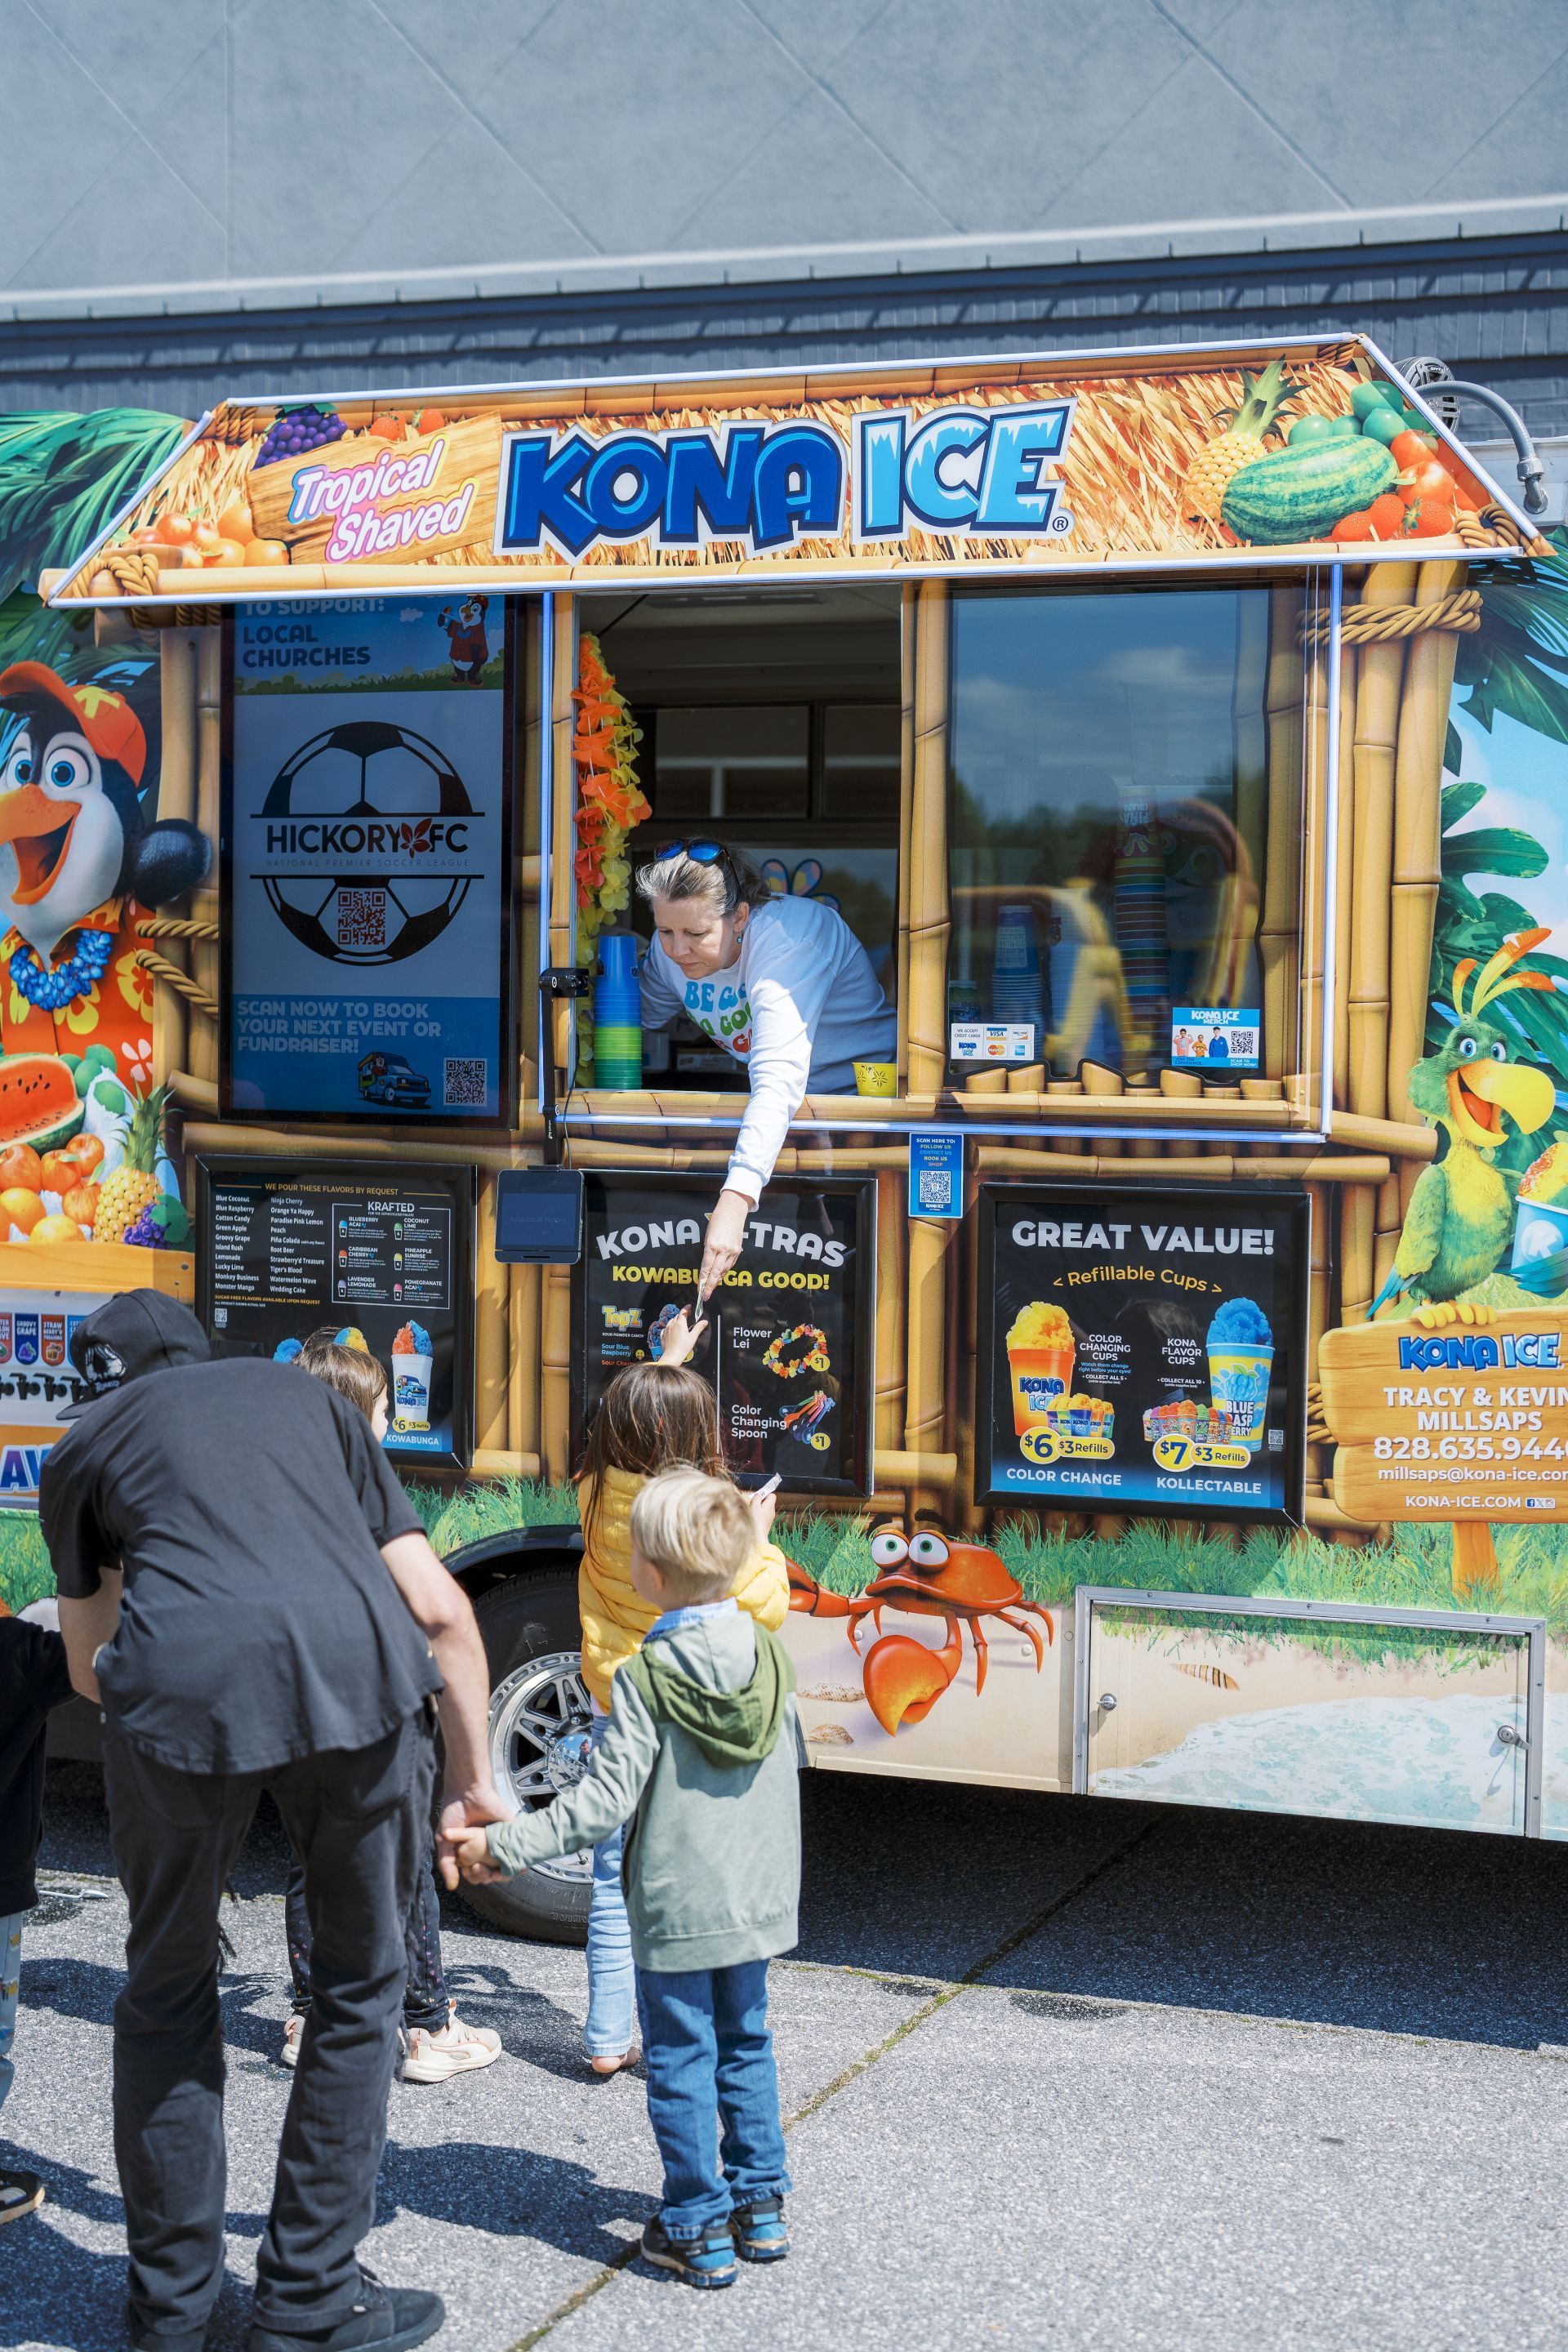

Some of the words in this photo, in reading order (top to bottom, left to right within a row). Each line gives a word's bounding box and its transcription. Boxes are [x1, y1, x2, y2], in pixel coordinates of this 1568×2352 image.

[292, 436, 447, 520] Tropical
[501, 424, 844, 559] KONA
[860, 405, 1070, 537] ICE
[327, 480, 475, 562] Shaved
[245, 600, 272, 616] TO
[278, 597, 384, 616] SUPPORT:
[243, 624, 318, 644] LOCAL
[243, 645, 371, 668] CHURCHES
[267, 823, 400, 853] HICKORY
[430, 822, 469, 853] FC
[266, 858, 319, 867] NATIONAL
[326, 858, 371, 867] PREMIER
[377, 858, 421, 867] SOCCER
[427, 858, 469, 867] LEAGUE
[684, 981, 715, 1012] BE
[237, 1000, 285, 1017] SCAN
[290, 1001, 337, 1018] NOW
[342, 1002, 368, 1018] TO
[373, 1003, 429, 1019] BOOK
[1191, 1010, 1221, 1020] KONA
[1222, 1010, 1240, 1021] ICE
[237, 1018, 288, 1035] YOUR
[293, 1019, 341, 1036] NEXT
[346, 1021, 409, 1037] EVENT
[412, 1022, 442, 1037] OR
[237, 1036, 359, 1054] FUNDRAISER!
[300, 1184, 321, 1192] THESE
[323, 1185, 354, 1194] FLAVORS
[367, 1187, 399, 1196] REQUEST
[270, 1197, 284, 1205] Ninja
[368, 1201, 414, 1213] KRAFTED
[229, 1205, 254, 1214] Raspberry
[270, 1207, 289, 1215] Orange
[234, 1215, 250, 1223] Candy
[216, 1234, 234, 1242] Groovy
[595, 1218, 700, 1260] KONA
[739, 1221, 847, 1267] -TRAS
[1012, 1220, 1131, 1250] GREAT
[1140, 1225, 1274, 1255] VALUE!
[216, 1273, 235, 1281] Monkey
[270, 1276, 301, 1284] Watermelon
[612, 1265, 752, 1287] KOWABGA
[758, 1271, 829, 1290] GOOD!
[1067, 1265, 1155, 1287] Refillable
[1160, 1269, 1207, 1293] Cups
[238, 1284, 255, 1292] Mango
[270, 1285, 292, 1294] Wedding
[602, 1305, 642, 1331] TopZ
[16, 1327, 37, 1335] GRAPE
[733, 1327, 772, 1338] Flower
[733, 1339, 750, 1348] Lei
[1089, 1334, 1122, 1343] COLOR
[1167, 1339, 1196, 1348] KONA
[1080, 1343, 1130, 1352] CHANGING
[1161, 1347, 1202, 1356] FLAVOR
[1398, 1334, 1499, 1372] KONA
[1501, 1332, 1561, 1370] ICE
[815, 1357, 824, 1368] $1
[1092, 1352, 1118, 1361] CUPS
[1168, 1356, 1195, 1365] CUPS
[1019, 1377, 1064, 1395] KONA
[1383, 1387, 1466, 1407] TRACY
[1472, 1387, 1493, 1407] &
[732, 1405, 761, 1414] Color
[1225, 1400, 1254, 1414] BLUE
[394, 1419, 406, 1430] $6
[732, 1416, 786, 1430] Changing
[1417, 1410, 1543, 1432] MILLSAPS
[386, 1434, 439, 1446] KOWABUNGA
[732, 1428, 768, 1439] Spoon
[815, 1436, 825, 1447] $1
[1024, 1433, 1053, 1458] $6
[1059, 1440, 1074, 1454] $3
[1075, 1443, 1108, 1453] Refills
[1160, 1440, 1187, 1464] $7
[1195, 1446, 1213, 1461] $3
[1215, 1452, 1245, 1462] Refills
[1006, 1468, 1056, 1482] COLOR
[1060, 1470, 1122, 1486] CHANGE
[1156, 1477, 1262, 1494] KOLLECTABLE
[1405, 1495, 1521, 1508] KONA-ICE.COM
